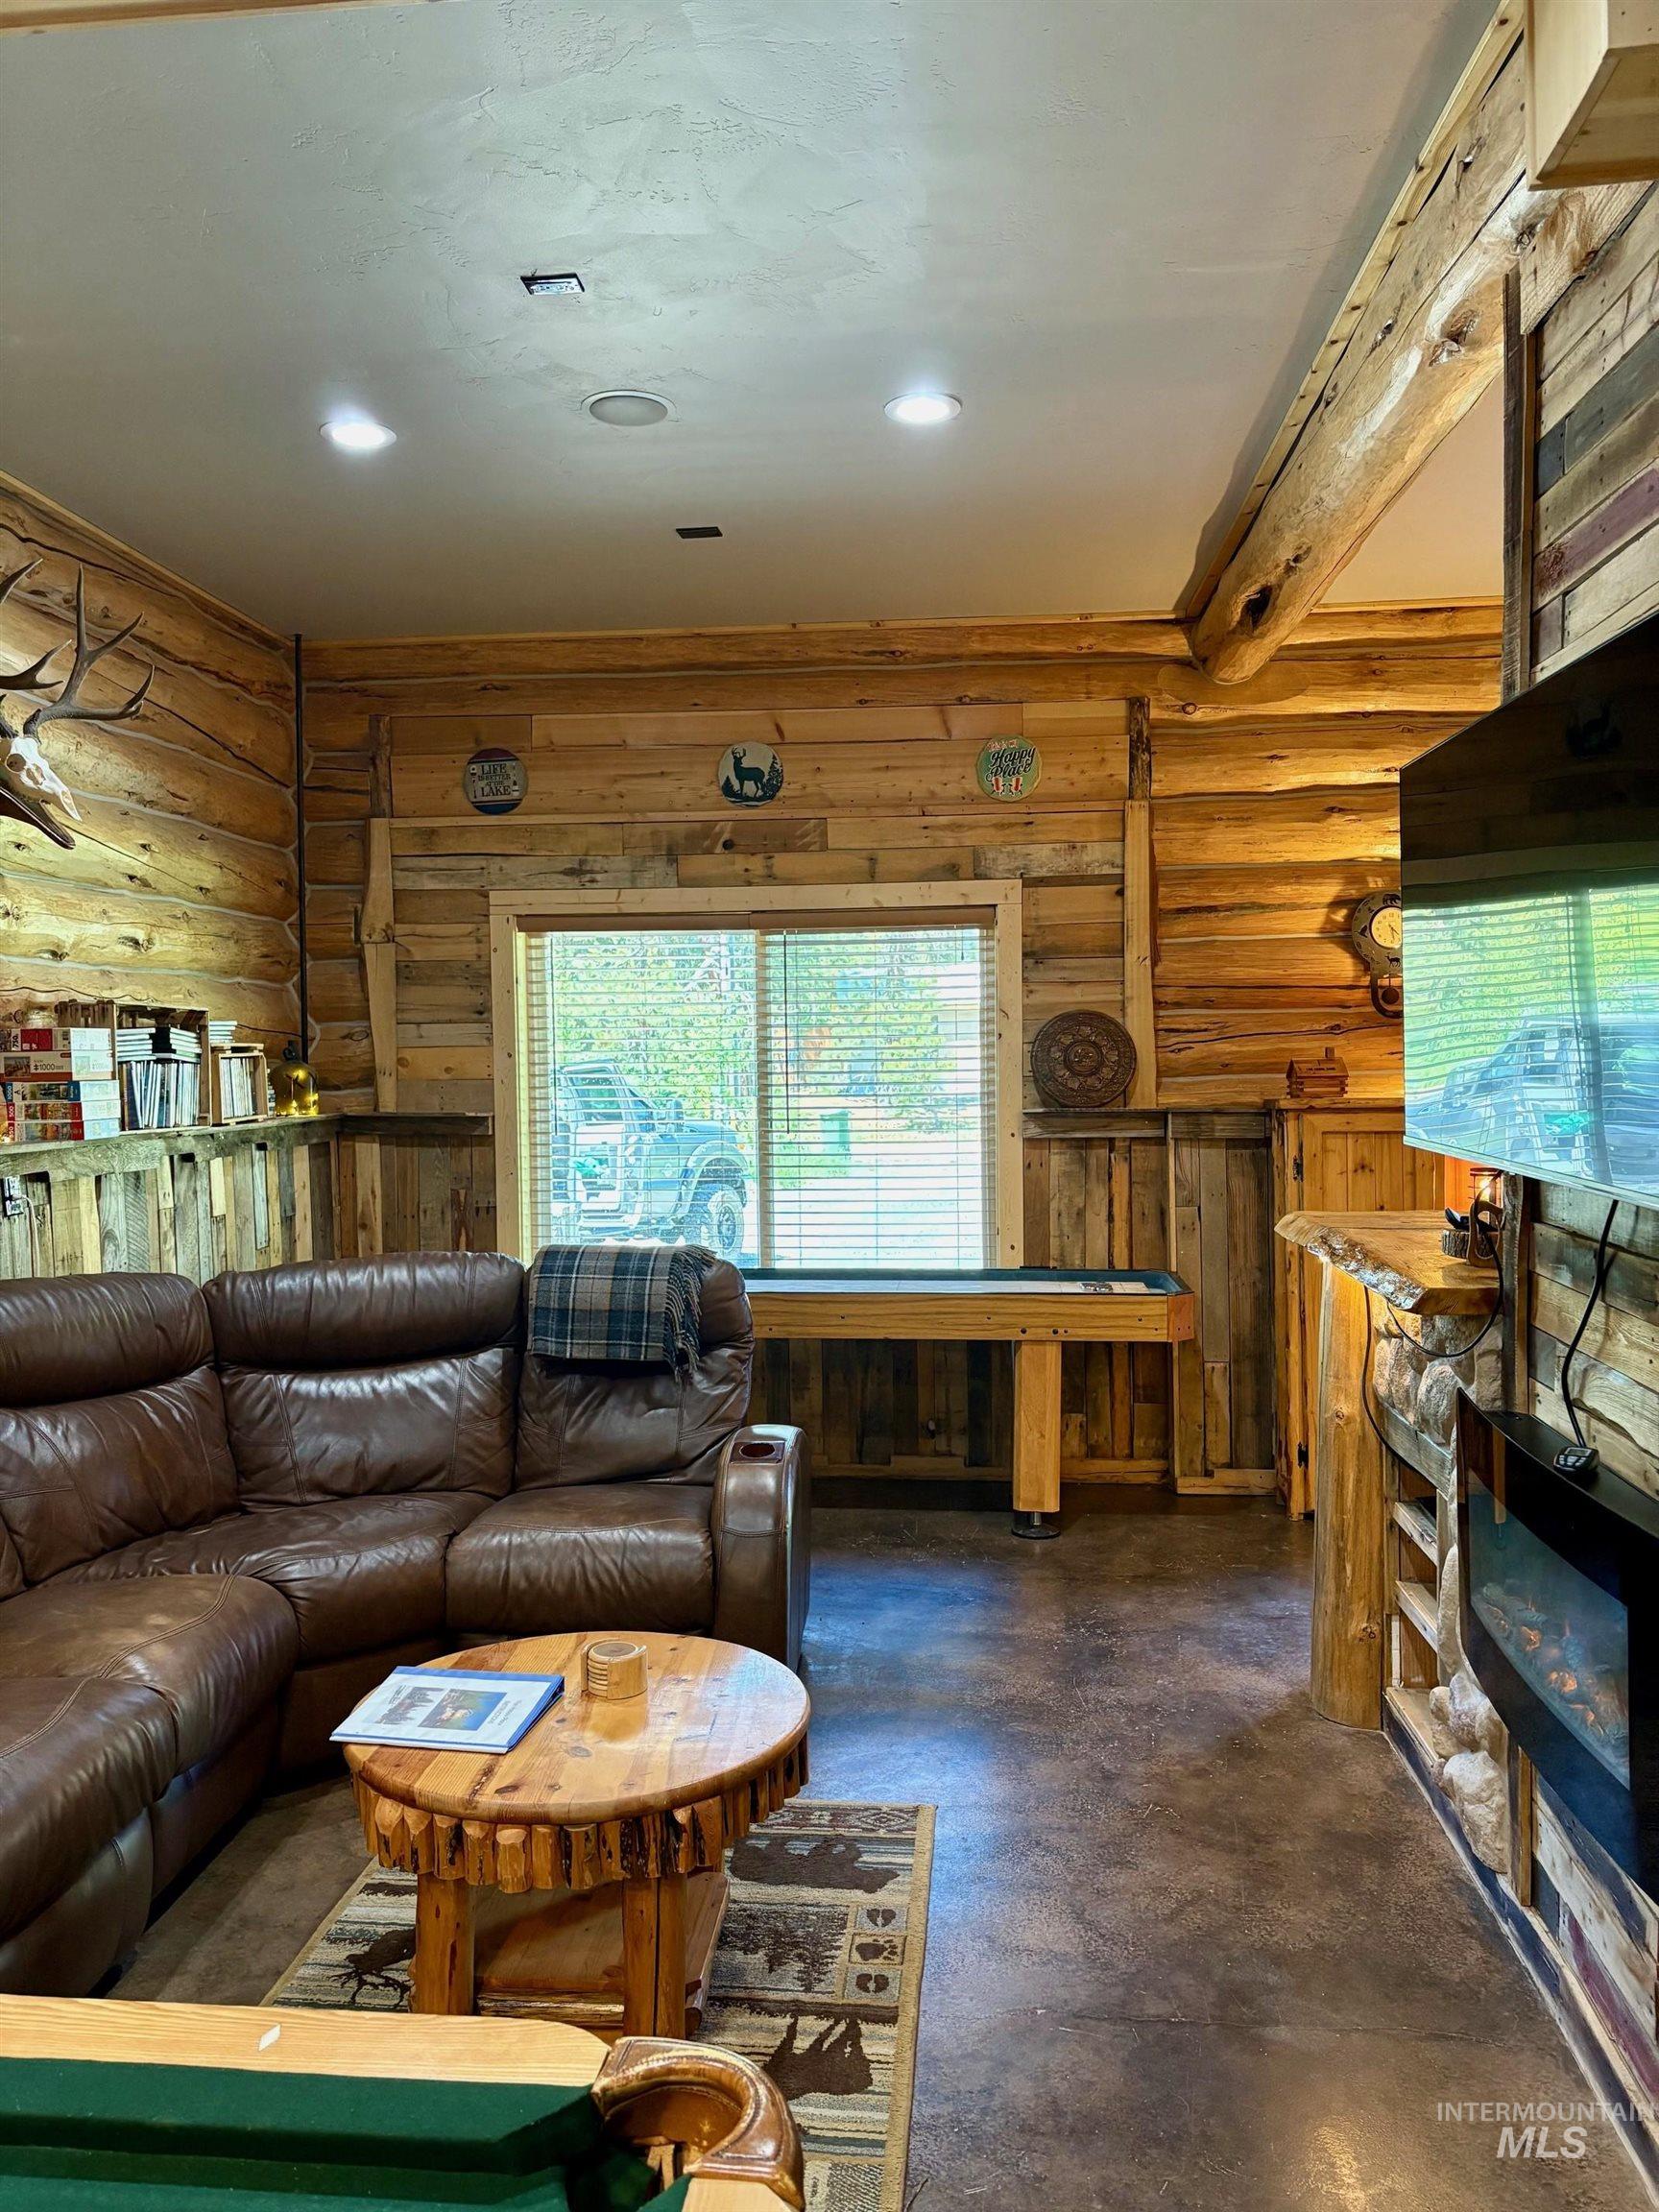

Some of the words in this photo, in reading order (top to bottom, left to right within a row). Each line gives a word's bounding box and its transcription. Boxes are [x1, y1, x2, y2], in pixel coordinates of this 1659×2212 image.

[991, 748, 1036, 768] Happy
[481, 763, 507, 775] LIFE
[986, 764, 1031, 782] Place
[481, 785, 511, 797] LAKE
